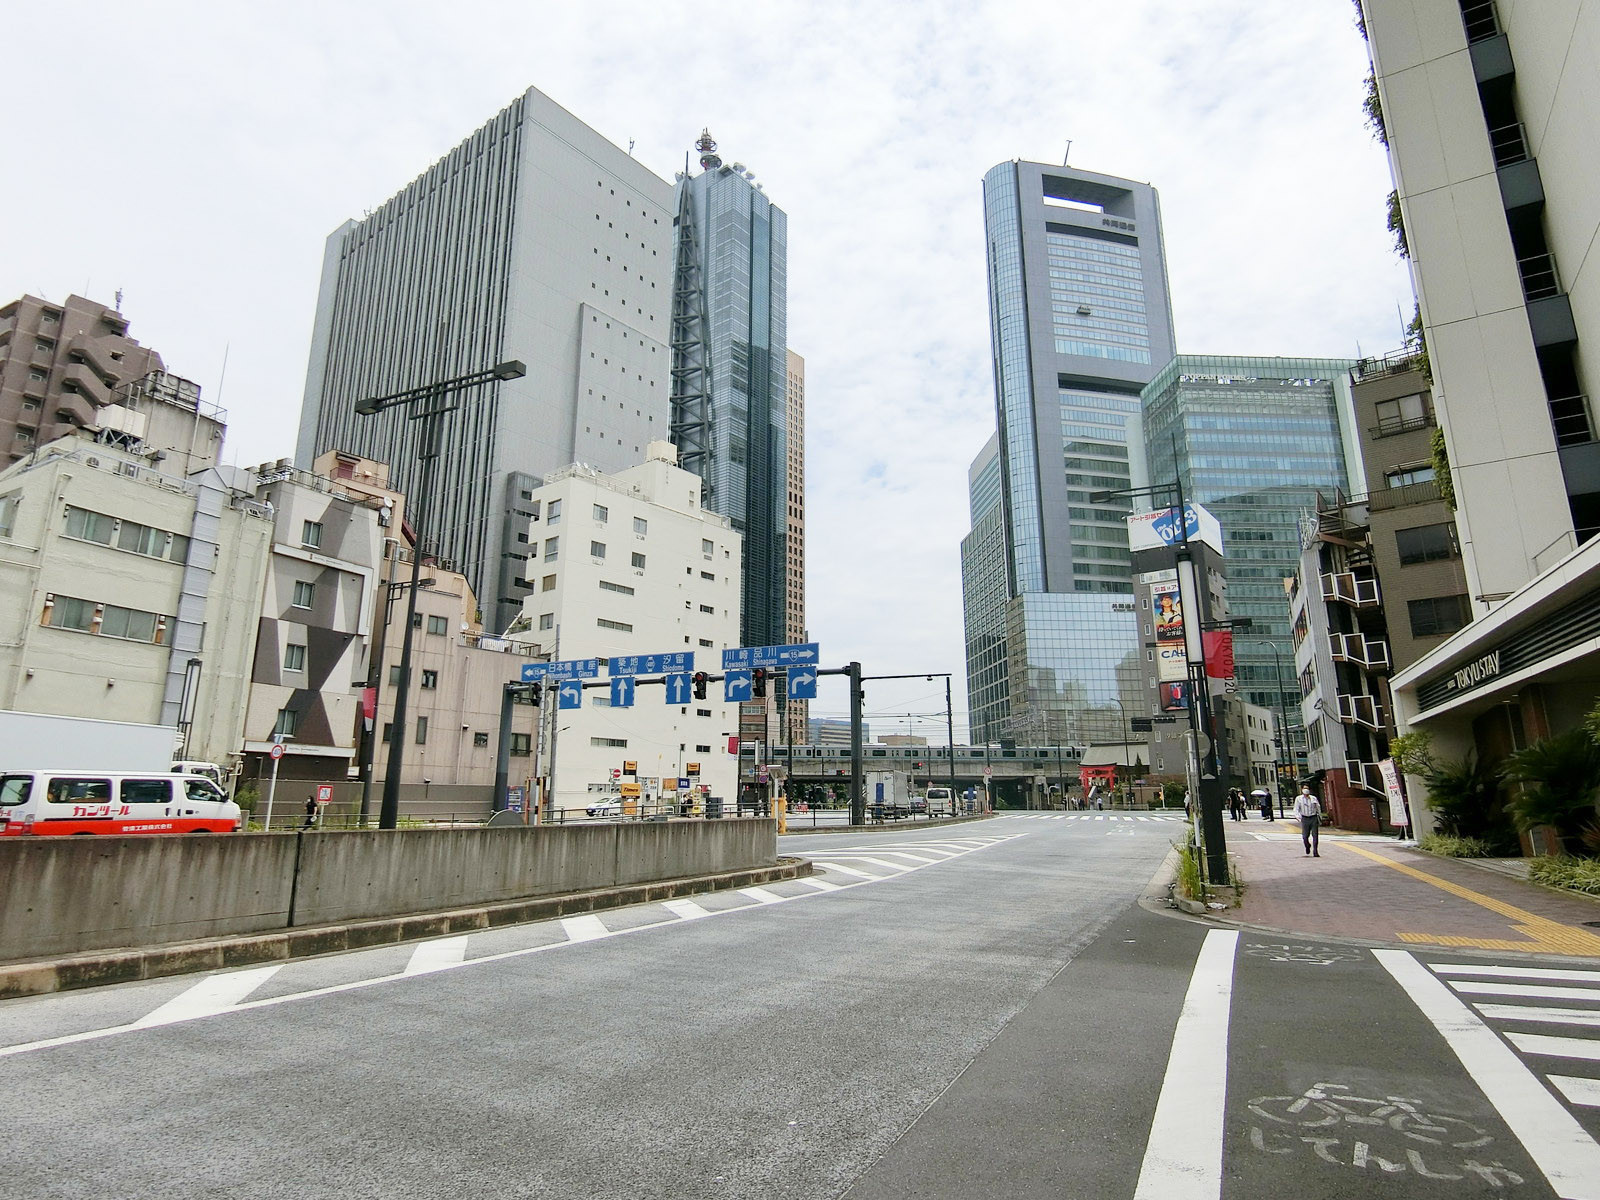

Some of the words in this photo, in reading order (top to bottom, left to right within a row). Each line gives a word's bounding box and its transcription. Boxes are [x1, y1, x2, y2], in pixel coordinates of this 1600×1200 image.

[1154, 584, 1178, 592] 引越はア
[726, 650, 748, 660] 川崎
[754, 647, 777, 658] 品川
[618, 657, 638, 666] 築地
[663, 654, 684, 664] 汐留
[725, 660, 748, 668] Kawasaki
[753, 658, 777, 666] Shinagawa
[549, 662, 572, 673] 日本橋
[576, 660, 596, 670] 銀座
[619, 665, 638, 674] Tsukiji
[662, 664, 684, 672] Shiodome
[1454, 662, 1480, 689] TOKYU
[1479, 650, 1499, 678] STAY
[73, 805, 131, 817] カンツール
